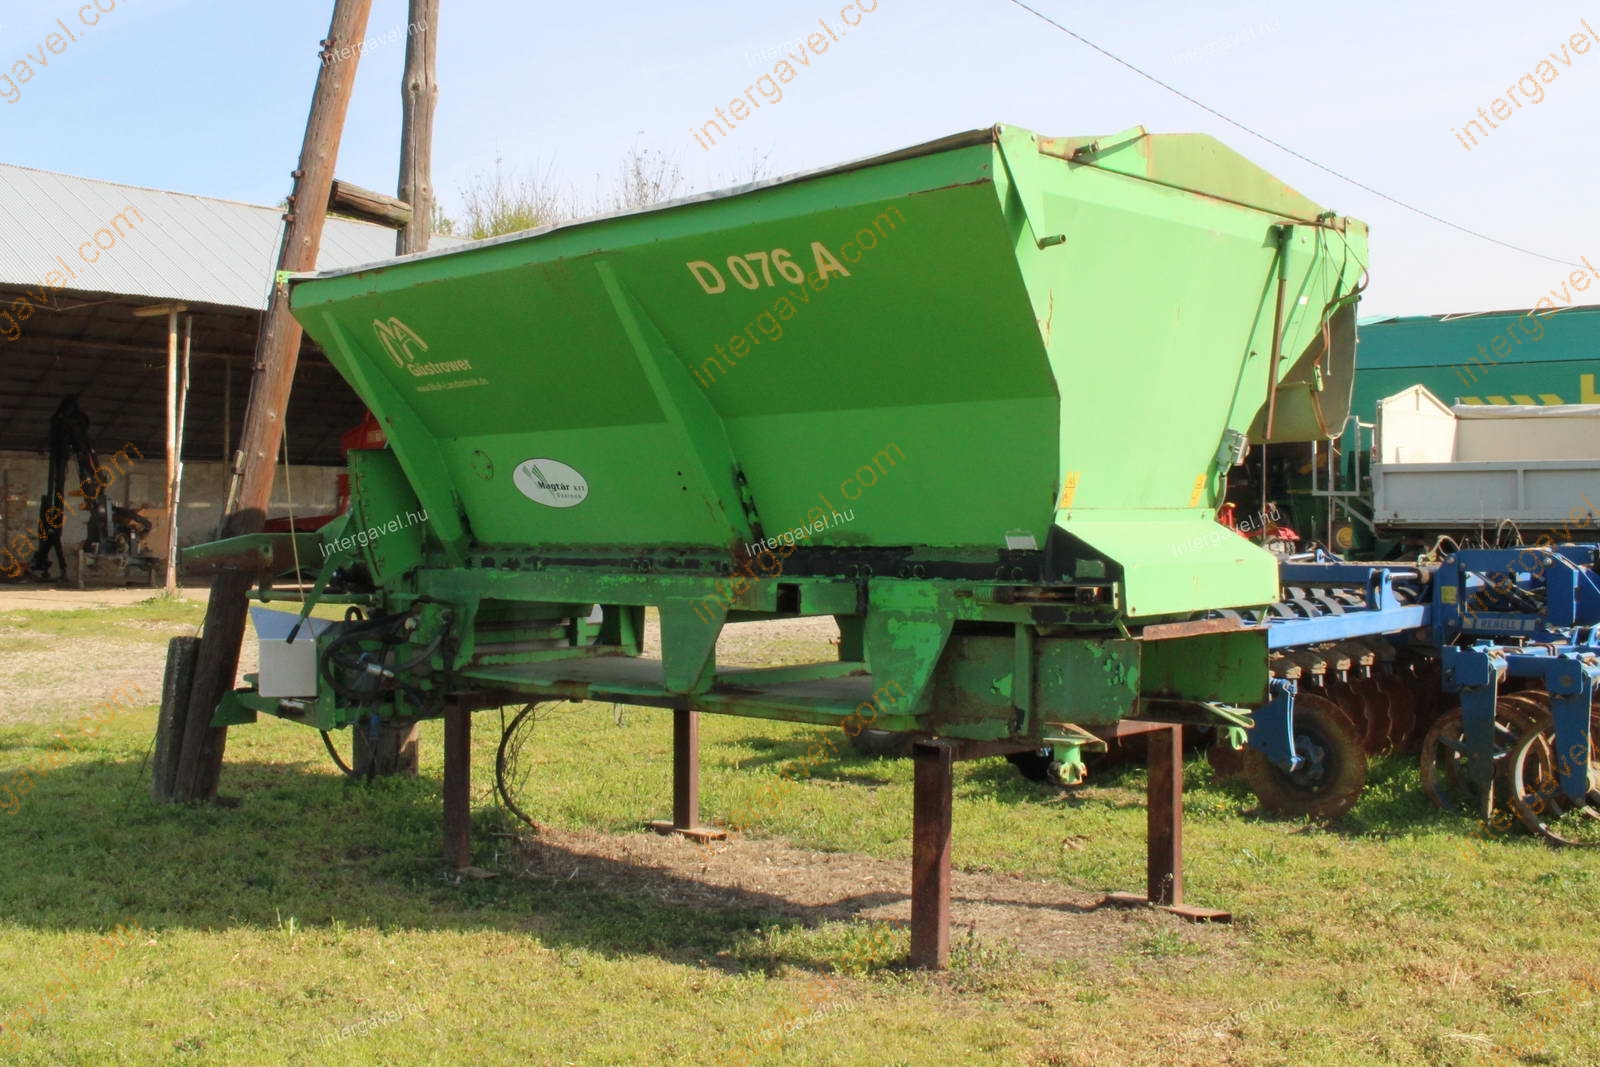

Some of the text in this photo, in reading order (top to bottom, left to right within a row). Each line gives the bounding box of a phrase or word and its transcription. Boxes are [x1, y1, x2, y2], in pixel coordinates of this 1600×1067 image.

[686, 241, 852, 295] D 076 A
